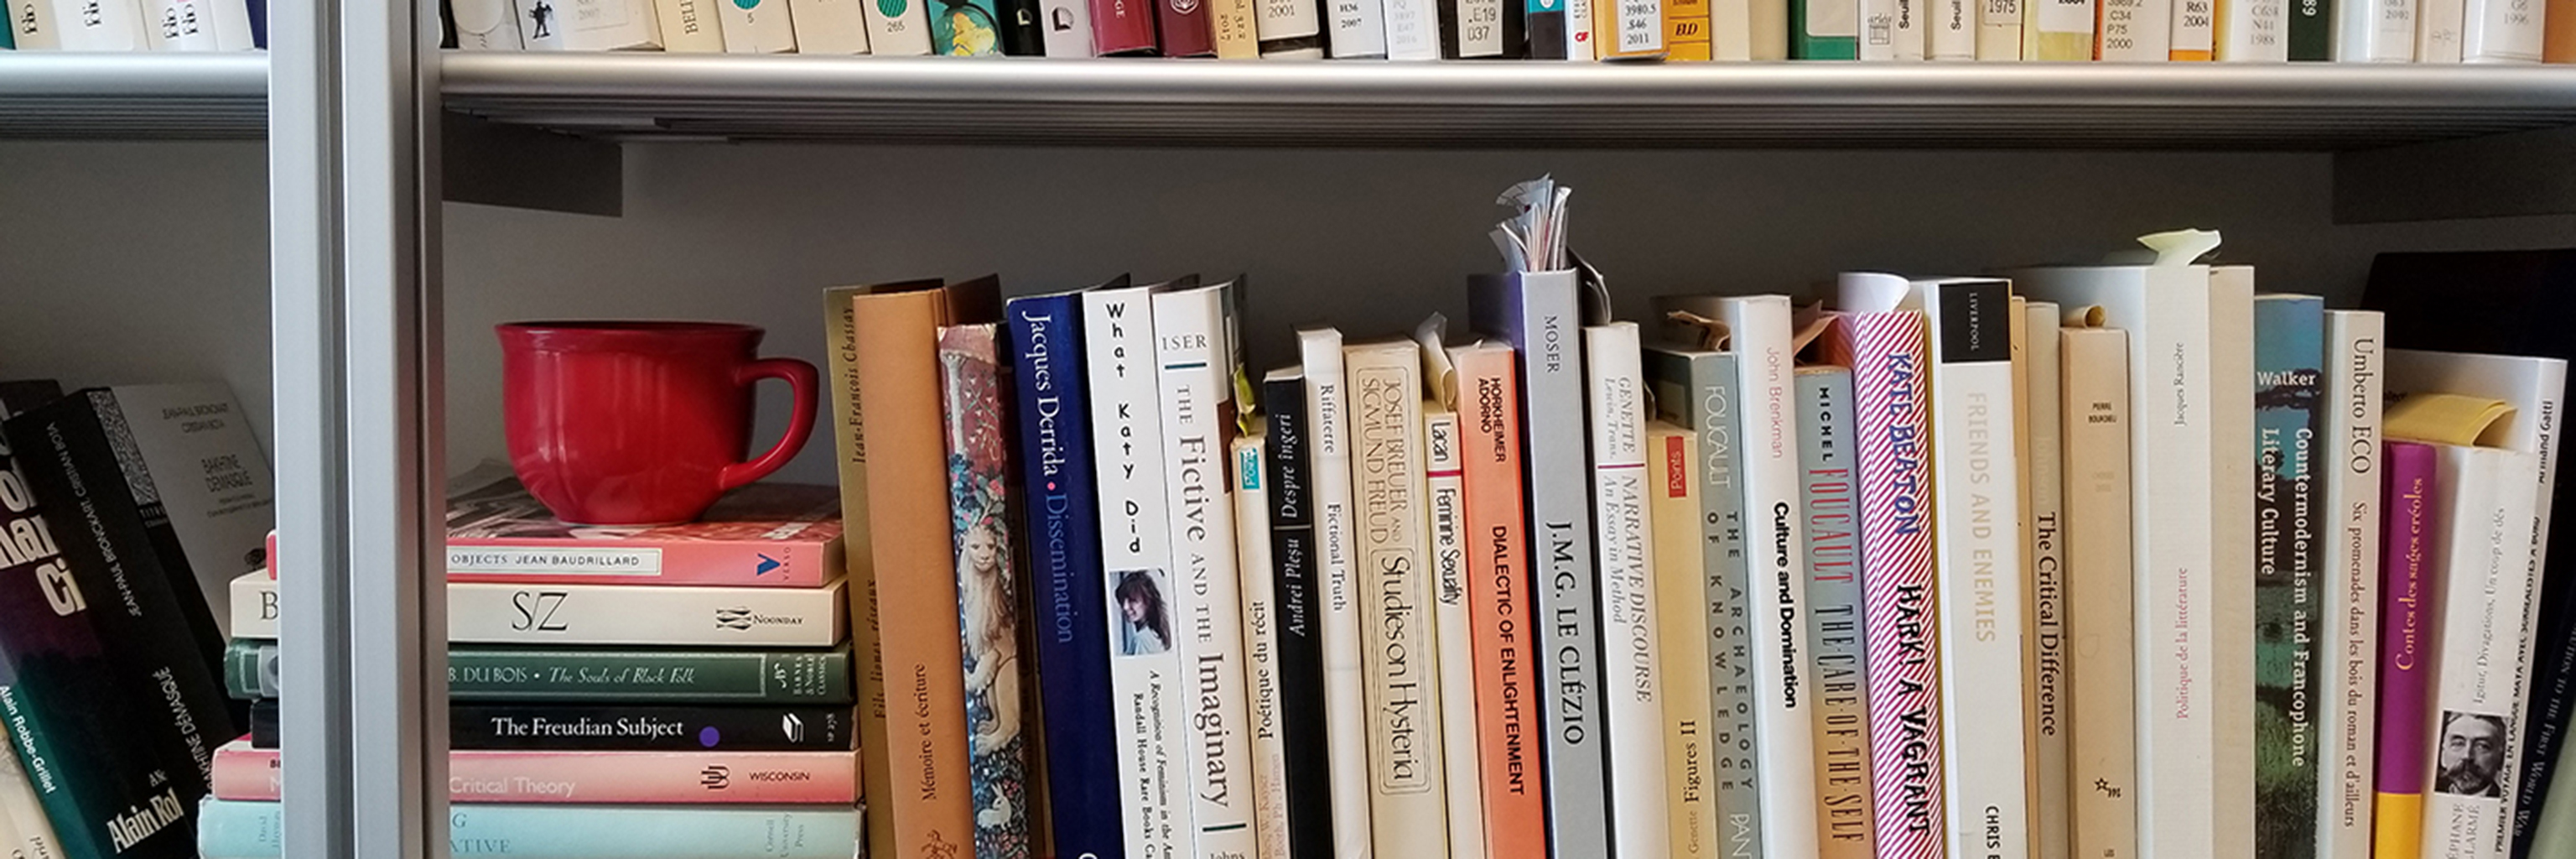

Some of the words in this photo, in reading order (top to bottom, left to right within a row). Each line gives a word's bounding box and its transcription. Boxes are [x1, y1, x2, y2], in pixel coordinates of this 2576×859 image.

[1269, 4, 1296, 18] 2001
[1627, 33, 1649, 44] 2011
[1950, 1, 1962, 30] Seuil
[2184, 15, 2210, 27] 2004
[2107, 38, 2133, 49] 2000
[1105, 302, 1125, 378] What
[1162, 335, 1208, 351] ISER
[1544, 315, 1561, 373] MOSER
[1969, 292, 1981, 351] LIVERPOOL
[1021, 310, 1052, 392] Jacques
[1766, 346, 1779, 383] John
[2257, 371, 2317, 387] Walker
[2353, 338, 2375, 419] Umberto
[1176, 385, 1193, 424] THE
[1383, 378, 1404, 436] JOSEF
[1478, 378, 1493, 434] ADORNO
[1887, 351, 1914, 417] KATE
[1037, 396, 1067, 476] Derrida
[1118, 403, 1135, 480] Katy
[1319, 384, 1337, 455] Riffaterre
[1362, 377, 1385, 475] SIGMUND
[1431, 421, 1451, 462] Lacan
[1490, 377, 1508, 463] HORKHEIMER
[1618, 376, 1636, 453] GENETTE
[1705, 385, 1731, 489] FOUCAULT
[1768, 387, 1784, 460] Brenkman
[1818, 387, 1834, 462] MICHEL
[1967, 392, 1992, 485] FRIENDS
[2540, 399, 2553, 432] Gatti
[1387, 439, 1409, 513] BREUER
[1670, 450, 1684, 491] Points
[2257, 427, 2280, 504] Literary
[2350, 425, 2372, 475] ECO
[1179, 436, 1210, 543] Fictive
[1280, 465, 1301, 518] Despre
[1603, 474, 1618, 497] An
[1889, 423, 1921, 536] BEATON
[2402, 478, 2423, 534] créoles
[1125, 500, 1140, 554] Did
[1327, 503, 1344, 565] Fictional
[1368, 481, 1389, 544] FREUD
[1436, 488, 1459, 547] Feminine
[1605, 502, 1620, 541] Essay
[1621, 475, 1645, 589] NARRATIVE
[1706, 512, 1720, 544] OF
[1726, 511, 1741, 558] THE
[1774, 502, 1790, 568] Culture
[1808, 468, 1854, 583] FOUCAULT
[1971, 493, 1992, 539] AND
[2038, 512, 2056, 551] The
[2293, 427, 2314, 604] Countermodernism
[2352, 502, 2368, 523] Six
[450, 554, 508, 566] OBJECTS
[515, 554, 548, 565] JEAN
[552, 554, 641, 567] BAUDRILLARD
[1045, 492, 1078, 644] Dissemination
[1545, 521, 1576, 599] J.M.G.
[2261, 508, 2280, 575] Culture
[2348, 527, 2367, 604] promenades
[1191, 553, 1207, 596] AND
[1332, 571, 1347, 611] Truth
[1382, 555, 1413, 641] Studies
[1439, 548, 1464, 607] Sexuality
[1492, 525, 1513, 616] DIALECTIC
[1609, 565, 1628, 625] Method
[1777, 572, 1794, 604] and
[1972, 549, 1996, 643] ENEMIES
[2038, 555, 2058, 627] Critical
[2174, 567, 2188, 629] littérature
[2397, 580, 2417, 609] des
[1196, 604, 1212, 643] THE
[1249, 601, 1266, 637] récit
[1285, 582, 1306, 638] Andrei
[1498, 620, 1514, 643] OF
[1556, 607, 1578, 638] LE
[1897, 584, 1926, 666] HARK!
[2293, 609, 2311, 644] and
[2350, 606, 2366, 635] dans
[1253, 642, 1267, 664] du
[1385, 643, 1407, 677] on
[1629, 590, 1652, 703] DISCOURSE
[1779, 607, 1800, 709] Domination
[2175, 644, 2189, 662] de
[2349, 638, 2365, 657] les
[2394, 612, 2415, 670] Contes
[464, 667, 488, 683] DU
[493, 667, 528, 683] BOIS
[548, 667, 574, 684] The
[578, 666, 610, 684] Souls
[613, 666, 627, 685] of
[631, 667, 665, 684] Black
[668, 668, 696, 684] Folk
[914, 664, 929, 717] écriture
[1559, 646, 1587, 745] CLÉZIO
[1710, 575, 1734, 790] KNOWLEDGE
[1729, 587, 1754, 789] ARCHAEOLOGY
[1898, 677, 1924, 697] A
[2040, 633, 2061, 737] Difference
[2176, 663, 2193, 720] Politique
[2348, 660, 2364, 685] bois
[2348, 688, 2363, 705] du
[490, 716, 528, 736] The
[532, 716, 613, 737] Freudian
[616, 717, 684, 740] Subject
[918, 721, 931, 735] et
[1134, 693, 1148, 735] Randall
[1194, 652, 1230, 808] Imaginary
[1256, 669, 1274, 740] Poétique
[1383, 682, 1420, 780] Hysteria
[1499, 647, 1524, 796] ENLIGHTENMENT
[1680, 720, 1696, 736] II
[2288, 650, 2311, 768] Francophone
[2347, 710, 2359, 750] roman
[13, 715, 56, 794] Robbe-Grillet
[749, 771, 811, 782] WISCONSIN
[919, 739, 937, 801] Mémoire
[1137, 739, 1147, 773] House
[1683, 742, 1702, 804] Figures
[1899, 705, 1930, 838] VAGRANT
[2345, 754, 2358, 768] et
[449, 776, 508, 794] Critical
[513, 776, 576, 798] Theory
[1140, 777, 1150, 802] Rare
[2344, 771, 2361, 827] d'ailleurs
[106, 805, 151, 855] Alain
[1142, 805, 1152, 840] Books
[1984, 805, 2001, 849] CHRIS
